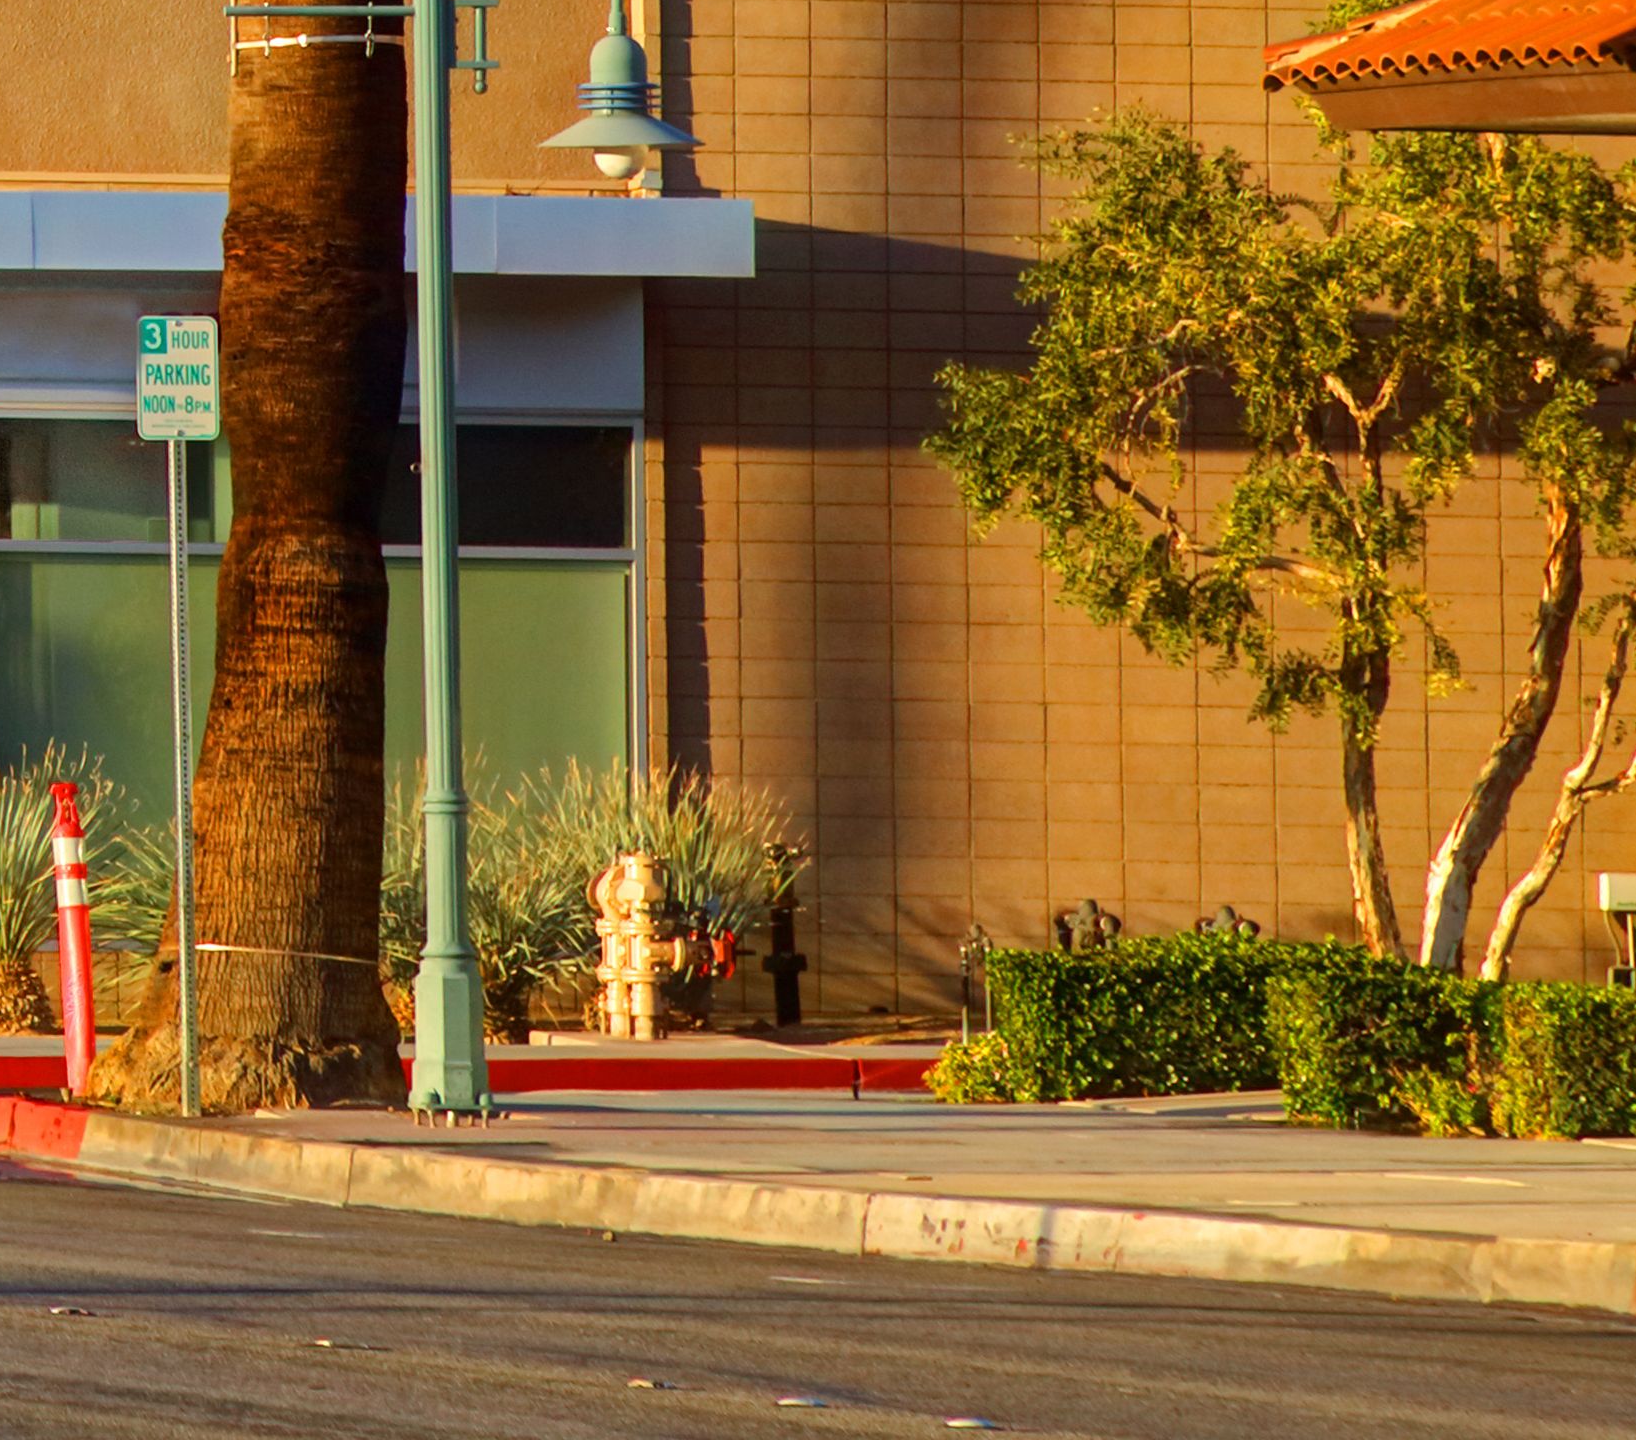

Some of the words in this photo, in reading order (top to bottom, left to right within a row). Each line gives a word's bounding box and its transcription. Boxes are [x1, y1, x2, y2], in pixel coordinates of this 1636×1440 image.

[144, 322, 162, 350] 3
[171, 330, 210, 350] HOUR
[146, 363, 211, 386] PARKING
